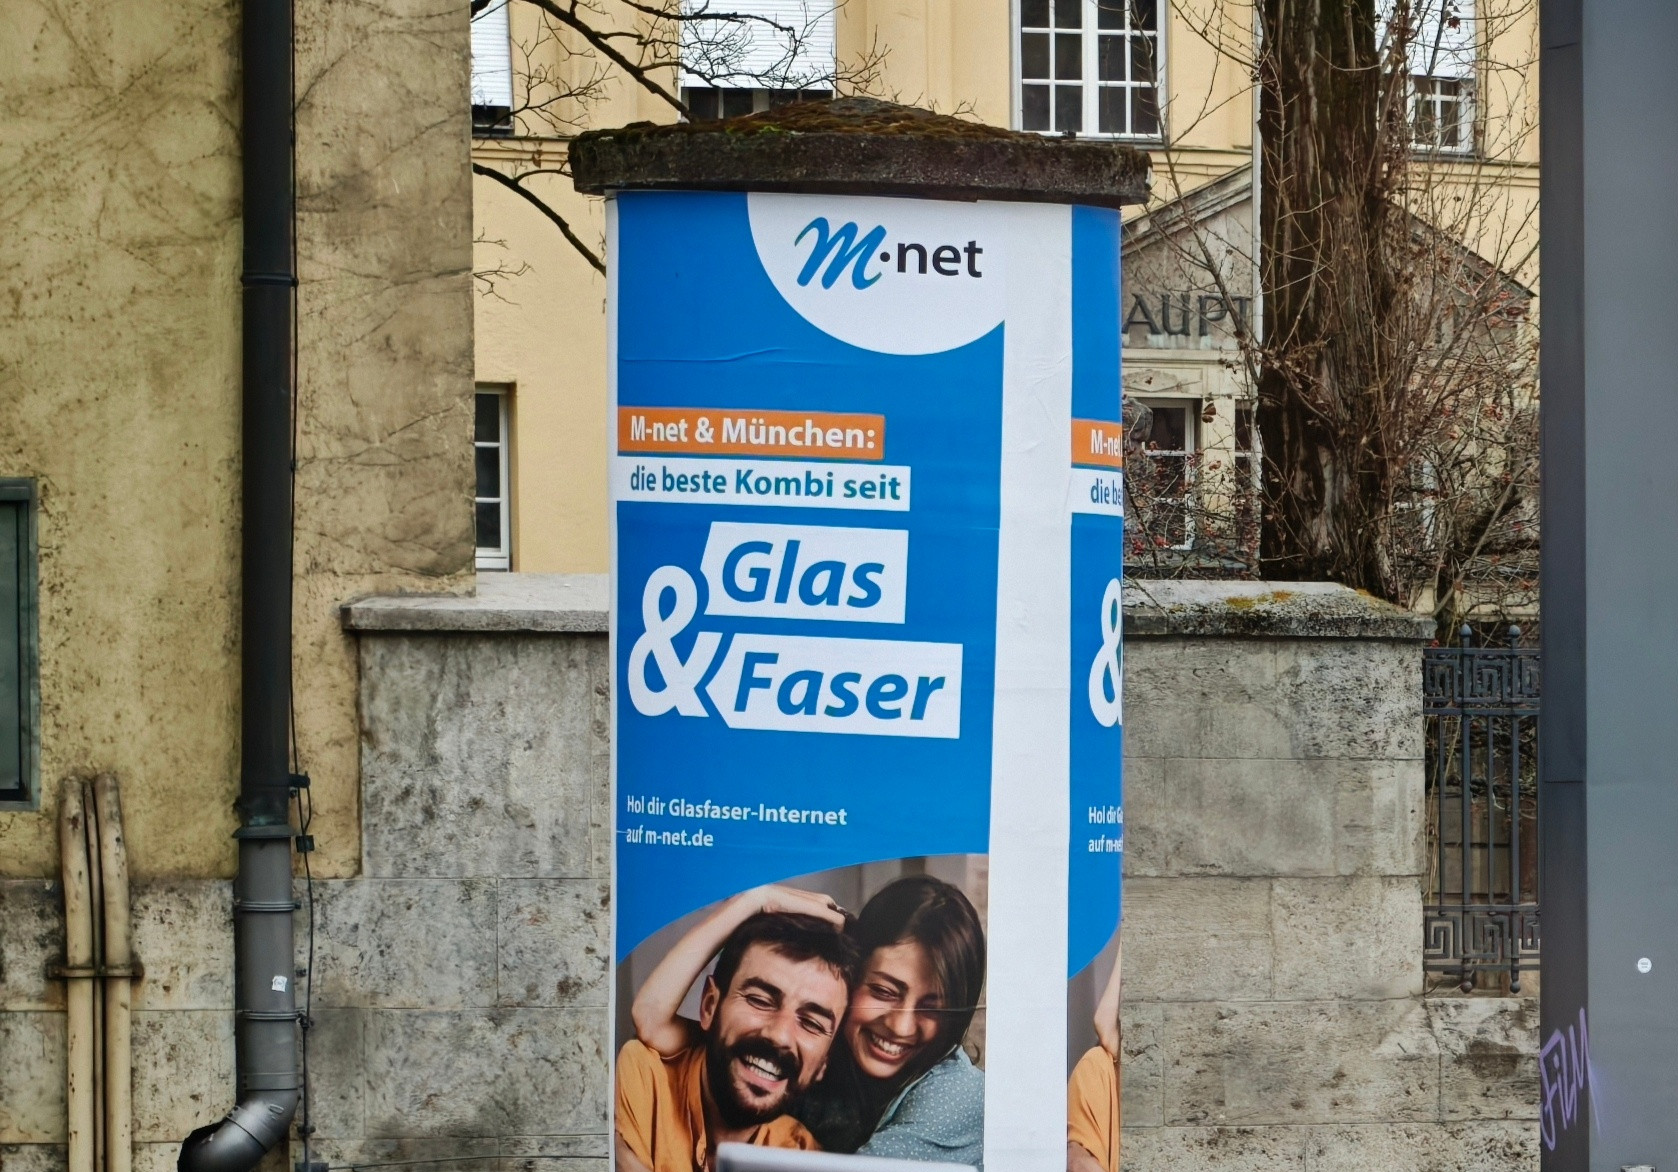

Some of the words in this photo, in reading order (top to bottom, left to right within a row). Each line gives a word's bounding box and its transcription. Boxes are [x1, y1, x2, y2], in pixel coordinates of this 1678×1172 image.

[630, 415, 688, 442] M-net
[694, 416, 715, 443] &
[722, 417, 876, 449] München:
[630, 465, 657, 492] die
[662, 466, 727, 494] beste
[735, 469, 834, 498] Kombi
[843, 473, 901, 500] seit
[1090, 478, 1110, 505] die
[721, 539, 885, 609] Glas
[628, 565, 722, 718] &
[733, 651, 946, 722] Faser
[627, 794, 645, 814] Hol
[647, 796, 666, 816] dir
[669, 798, 848, 826] Glasfaser-Internet
[1088, 805, 1106, 825] Hol
[626, 824, 644, 844] auf
[645, 828, 714, 847] m-net.de
[1088, 834, 1106, 853] auf
